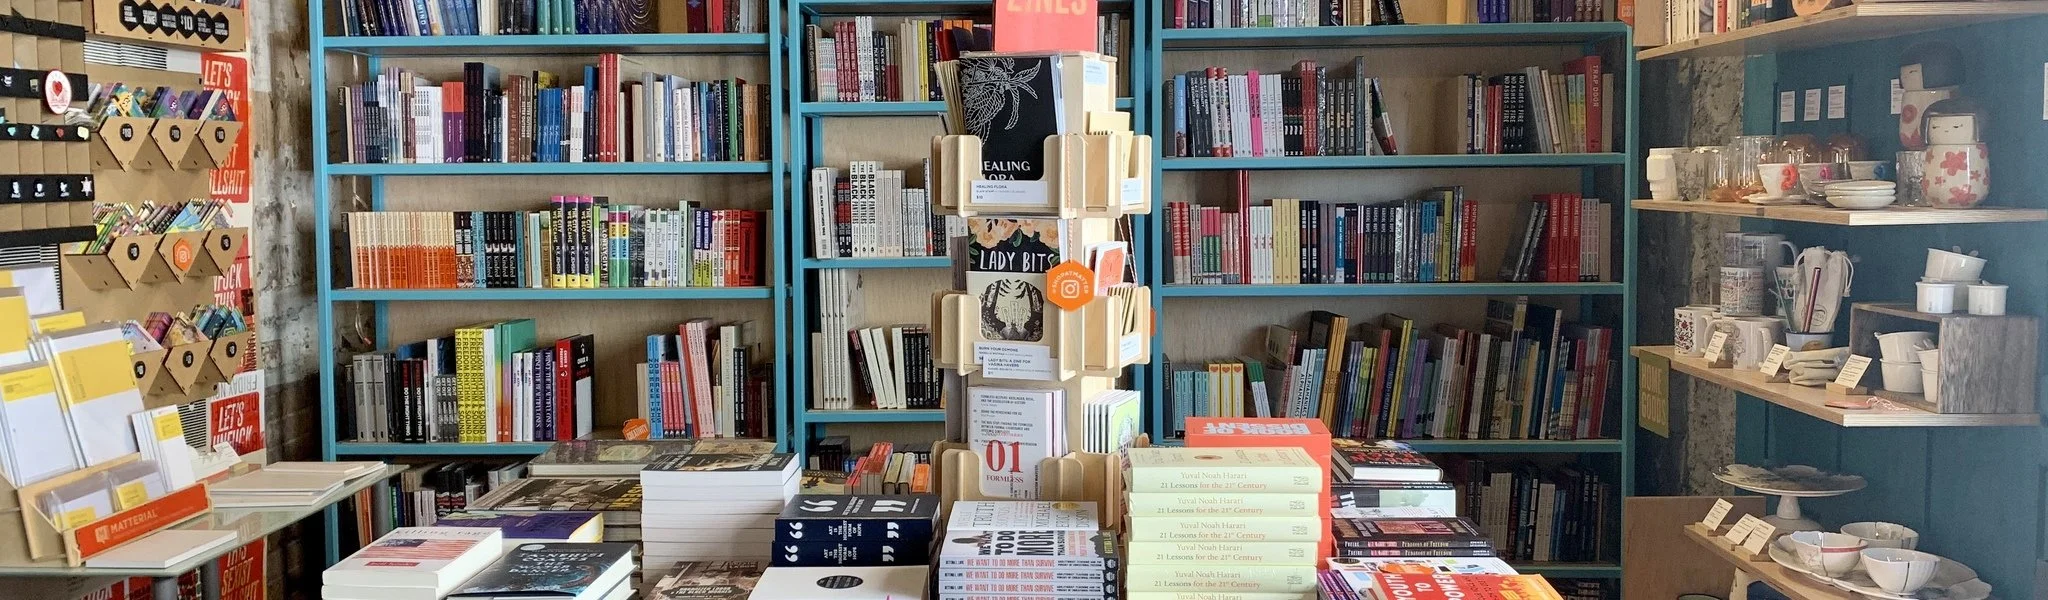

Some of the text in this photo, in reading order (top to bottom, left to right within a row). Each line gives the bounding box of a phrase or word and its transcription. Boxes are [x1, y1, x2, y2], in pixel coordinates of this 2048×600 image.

[204, 61, 232, 86] LET'S
[982, 160, 1030, 171] EALING
[209, 170, 246, 195] LLSHIT
[979, 250, 1055, 272] LADY BITS
[1642, 362, 1662, 394] HOME
[1295, 374, 1305, 417] ALPHAMANIACS
[1302, 374, 1312, 417] ALPHAMANIACS
[219, 401, 245, 432] LET'S
[1642, 392, 1666, 426] GOODS
[986, 440, 1023, 473] 01
[986, 475, 1024, 483] FORMLESS
[1237, 482, 1267, 490] Century
[111, 509, 157, 534] MATTERIAL
[973, 502, 995, 527] TRUTH
[1036, 502, 1050, 527] MICHAEL
[1056, 514, 1069, 527] ERIC
[1076, 509, 1090, 527] DYSON
[978, 544, 990, 555] WE
[995, 531, 1016, 555] TO DO
[1016, 531, 1054, 556] MORE
[222, 558, 254, 596] SEXIST
[1384, 574, 1414, 600] YOUTH
[1415, 582, 1434, 592] TO
